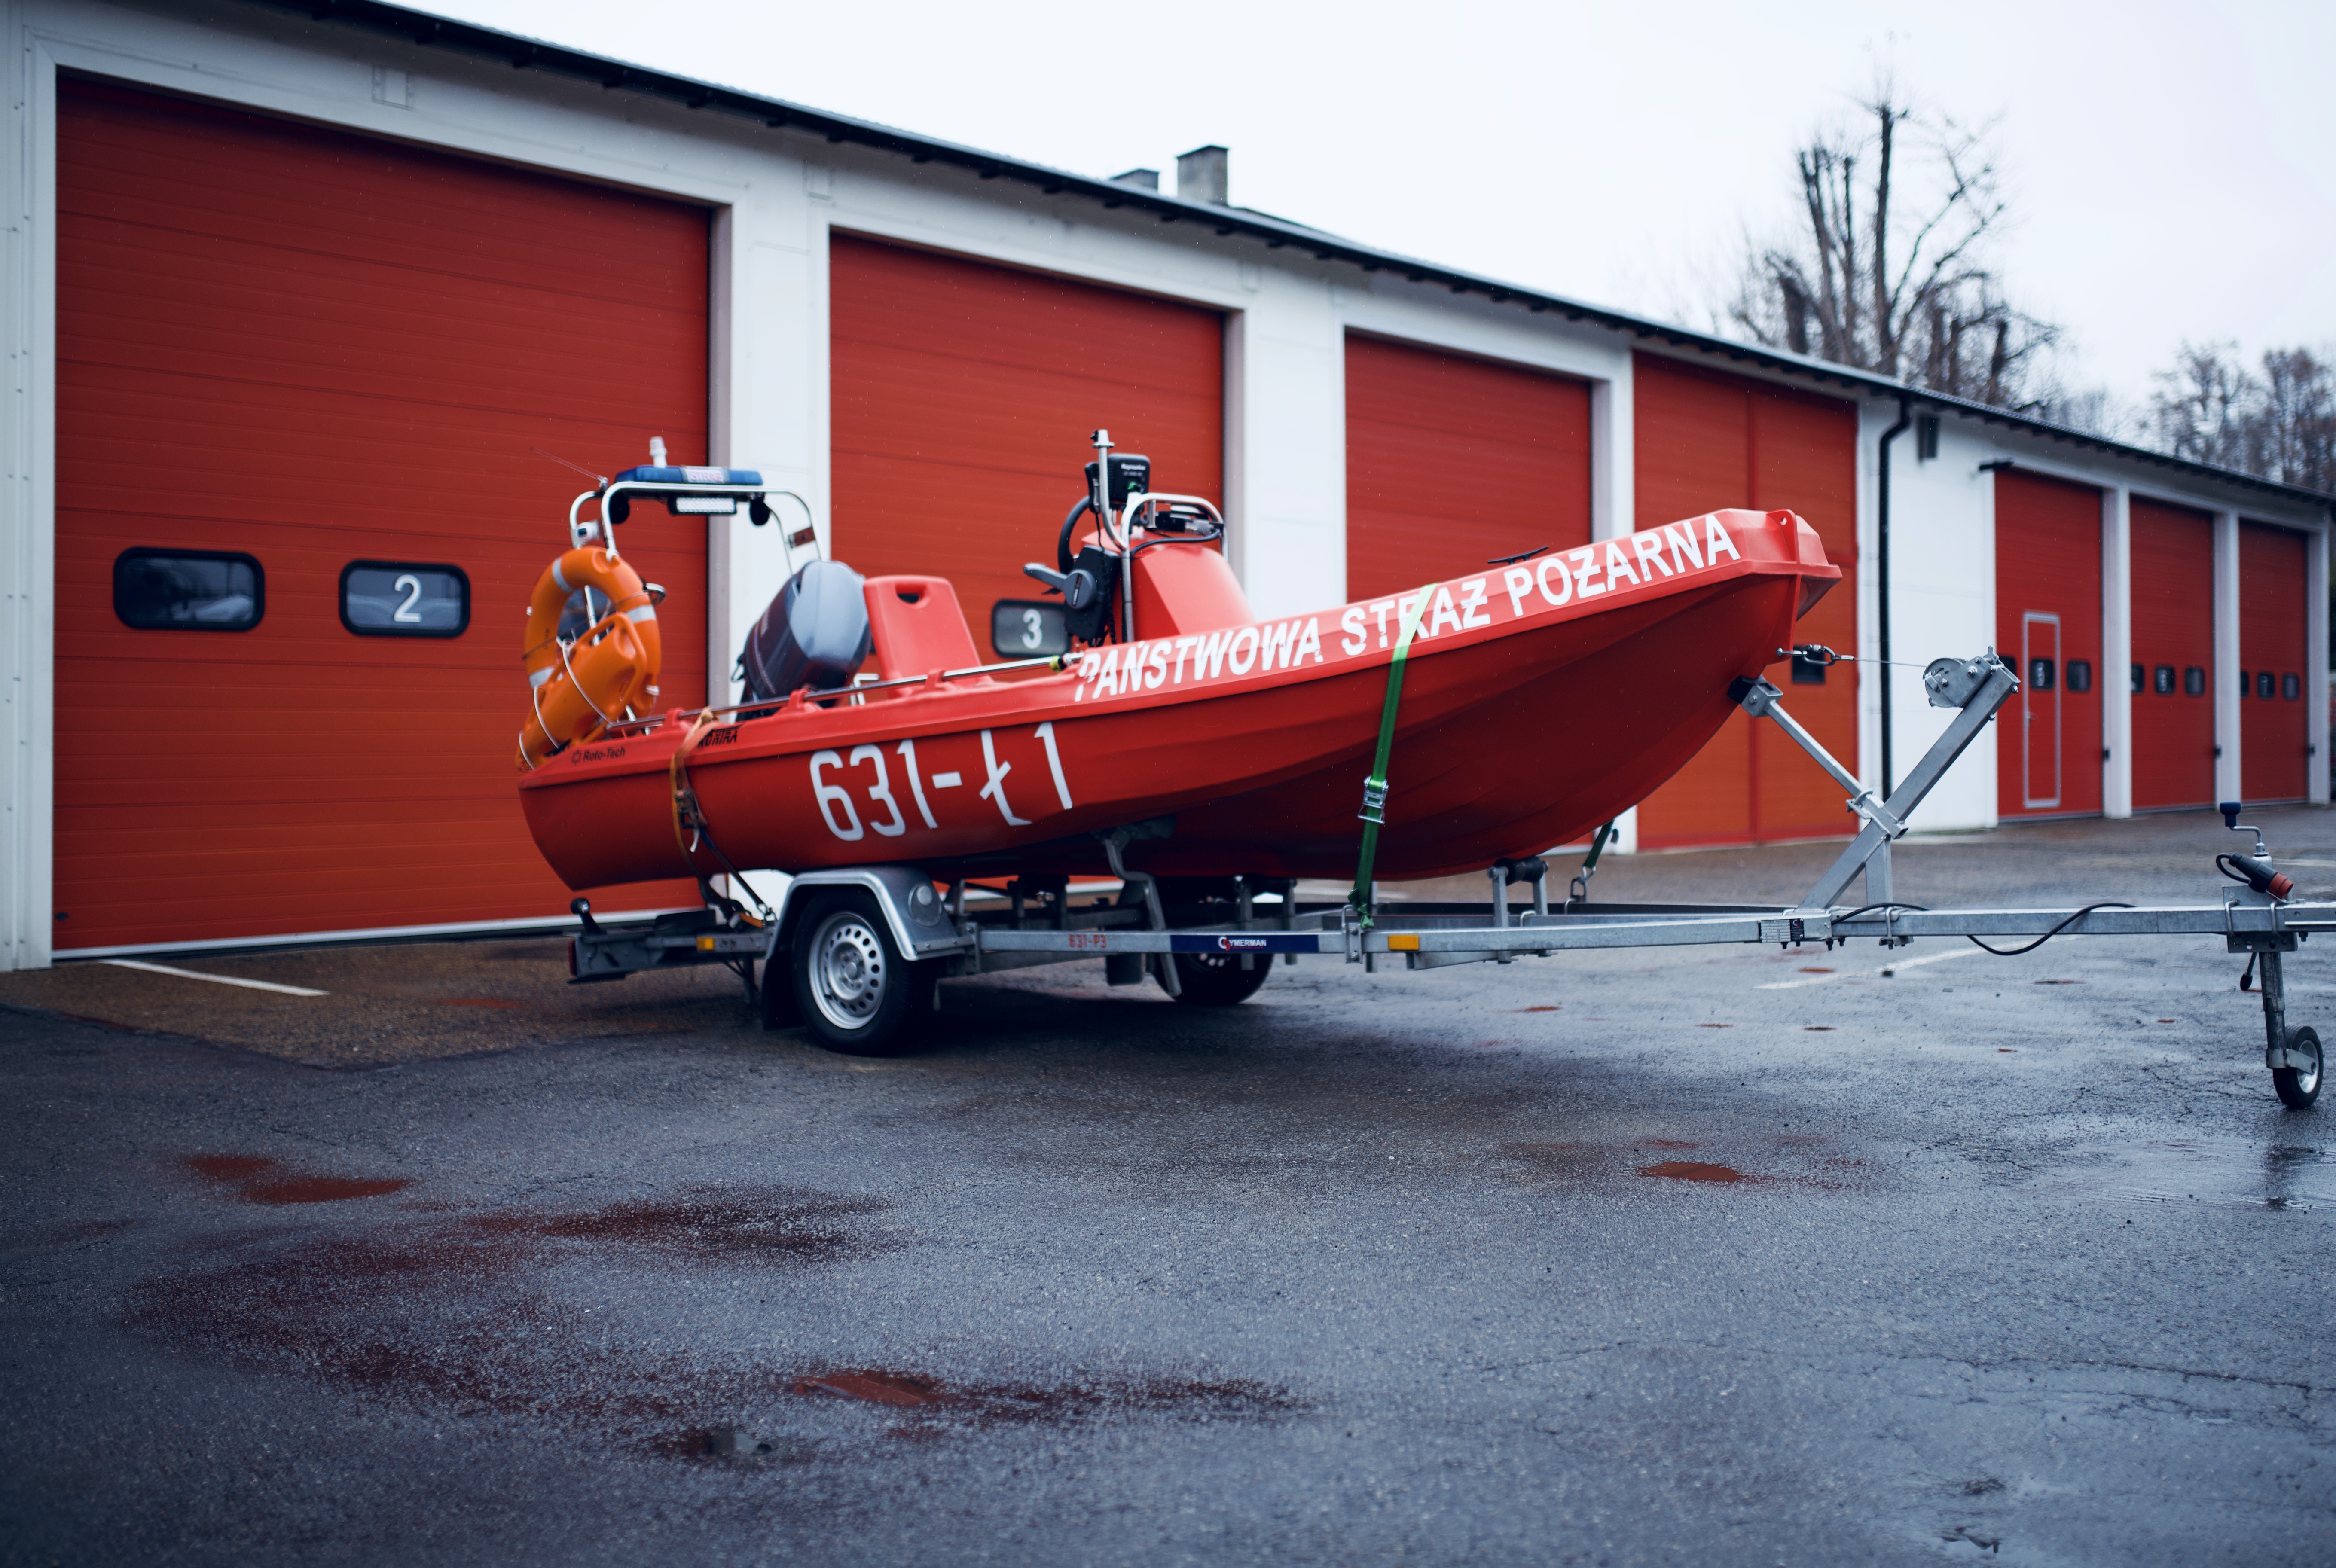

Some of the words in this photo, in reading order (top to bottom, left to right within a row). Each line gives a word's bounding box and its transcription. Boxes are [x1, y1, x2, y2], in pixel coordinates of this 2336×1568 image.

[394, 574, 423, 623] 2
[1023, 608, 1043, 649] 3
[1075, 617, 1323, 702] PAŃSTWOWA
[583, 746, 626, 762] Roto-Tech
[1069, 934, 1107, 948] 631-P3
